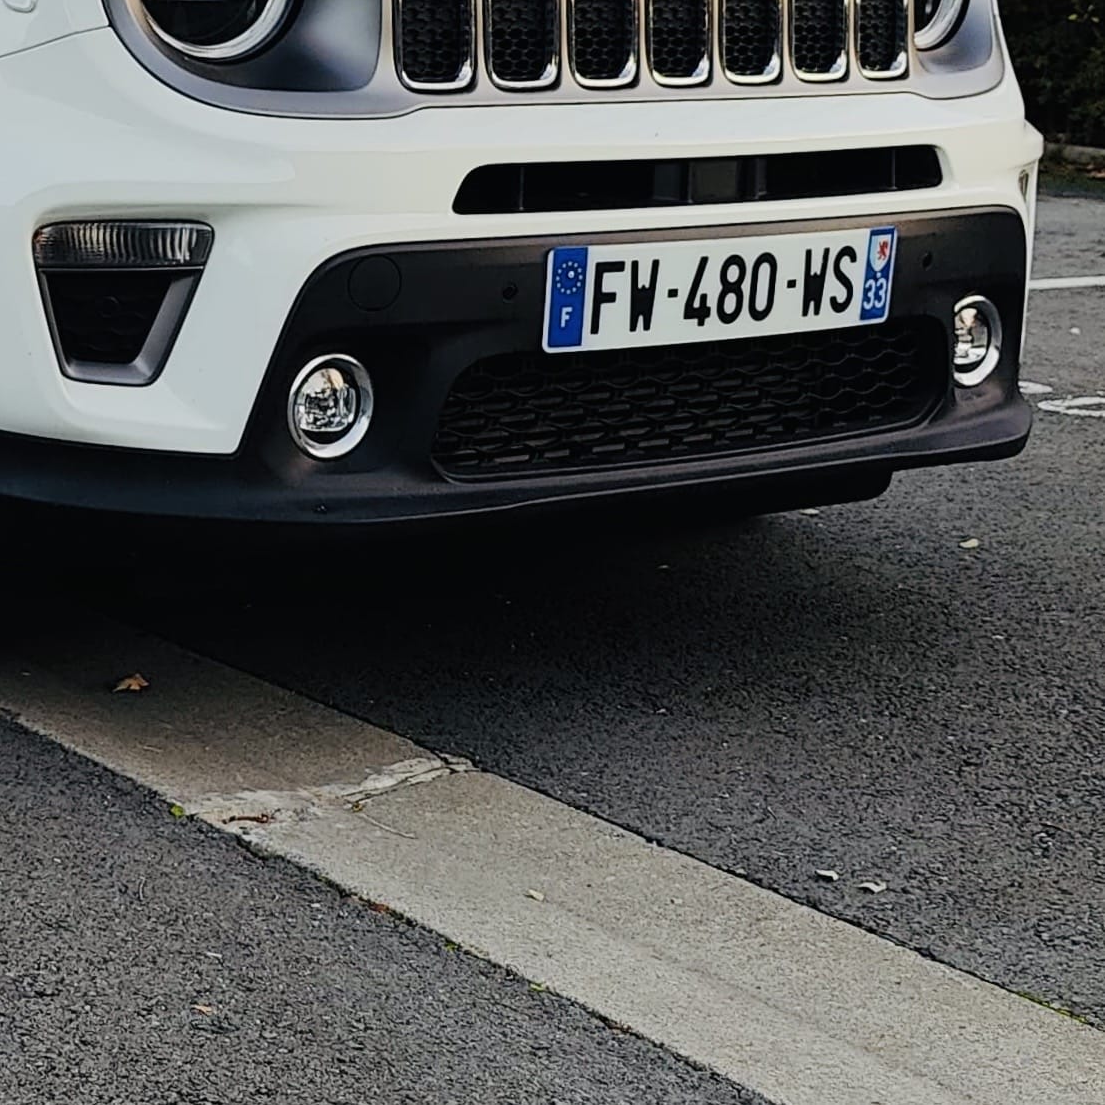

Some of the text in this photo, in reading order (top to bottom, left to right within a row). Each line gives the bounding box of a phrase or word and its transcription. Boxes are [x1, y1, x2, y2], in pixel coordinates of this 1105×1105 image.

[590, 245, 857, 335] FW-480-WS
[862, 279, 887, 311] 33
[560, 307, 573, 328] F
